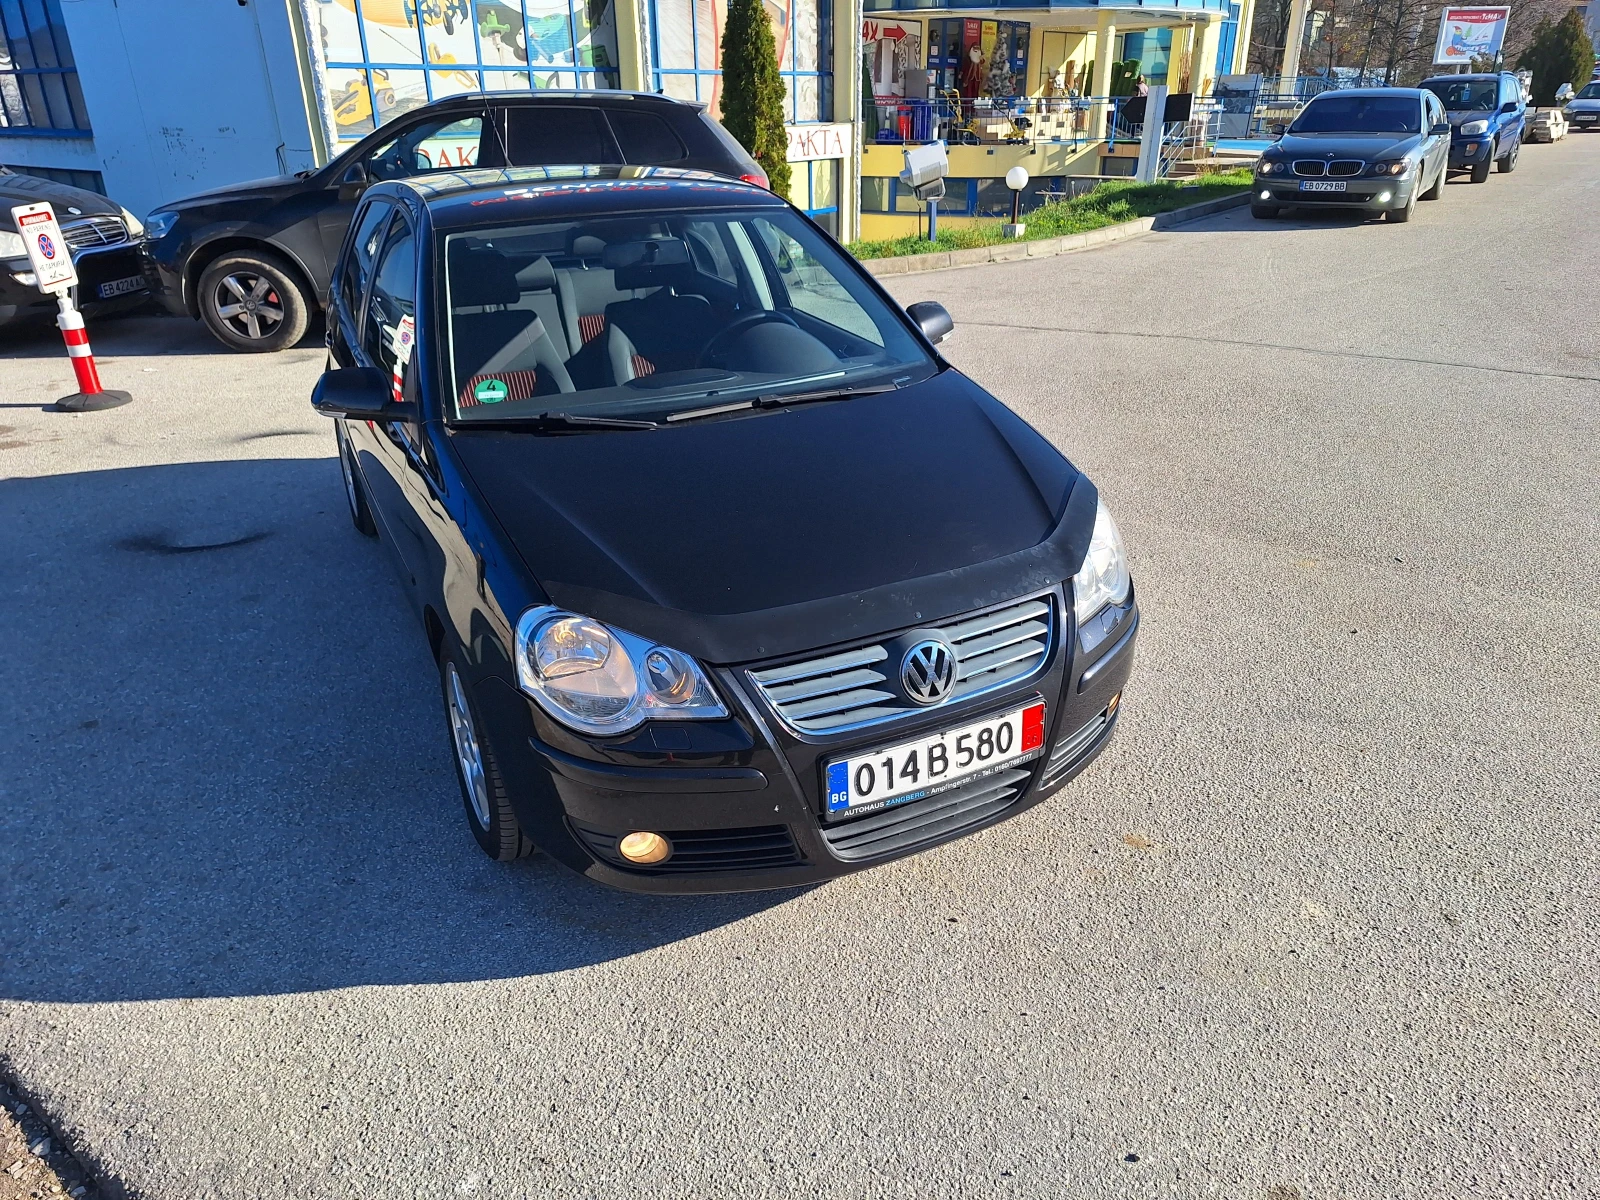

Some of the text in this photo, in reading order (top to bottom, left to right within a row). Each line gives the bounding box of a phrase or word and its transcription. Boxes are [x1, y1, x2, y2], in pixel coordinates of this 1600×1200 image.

[1315, 182, 1334, 190] 0729
[486, 380, 497, 391] 4
[831, 791, 847, 804] BG
[843, 801, 885, 817] AUTOHAUS
[886, 790, 925, 806] ZANGBERG
